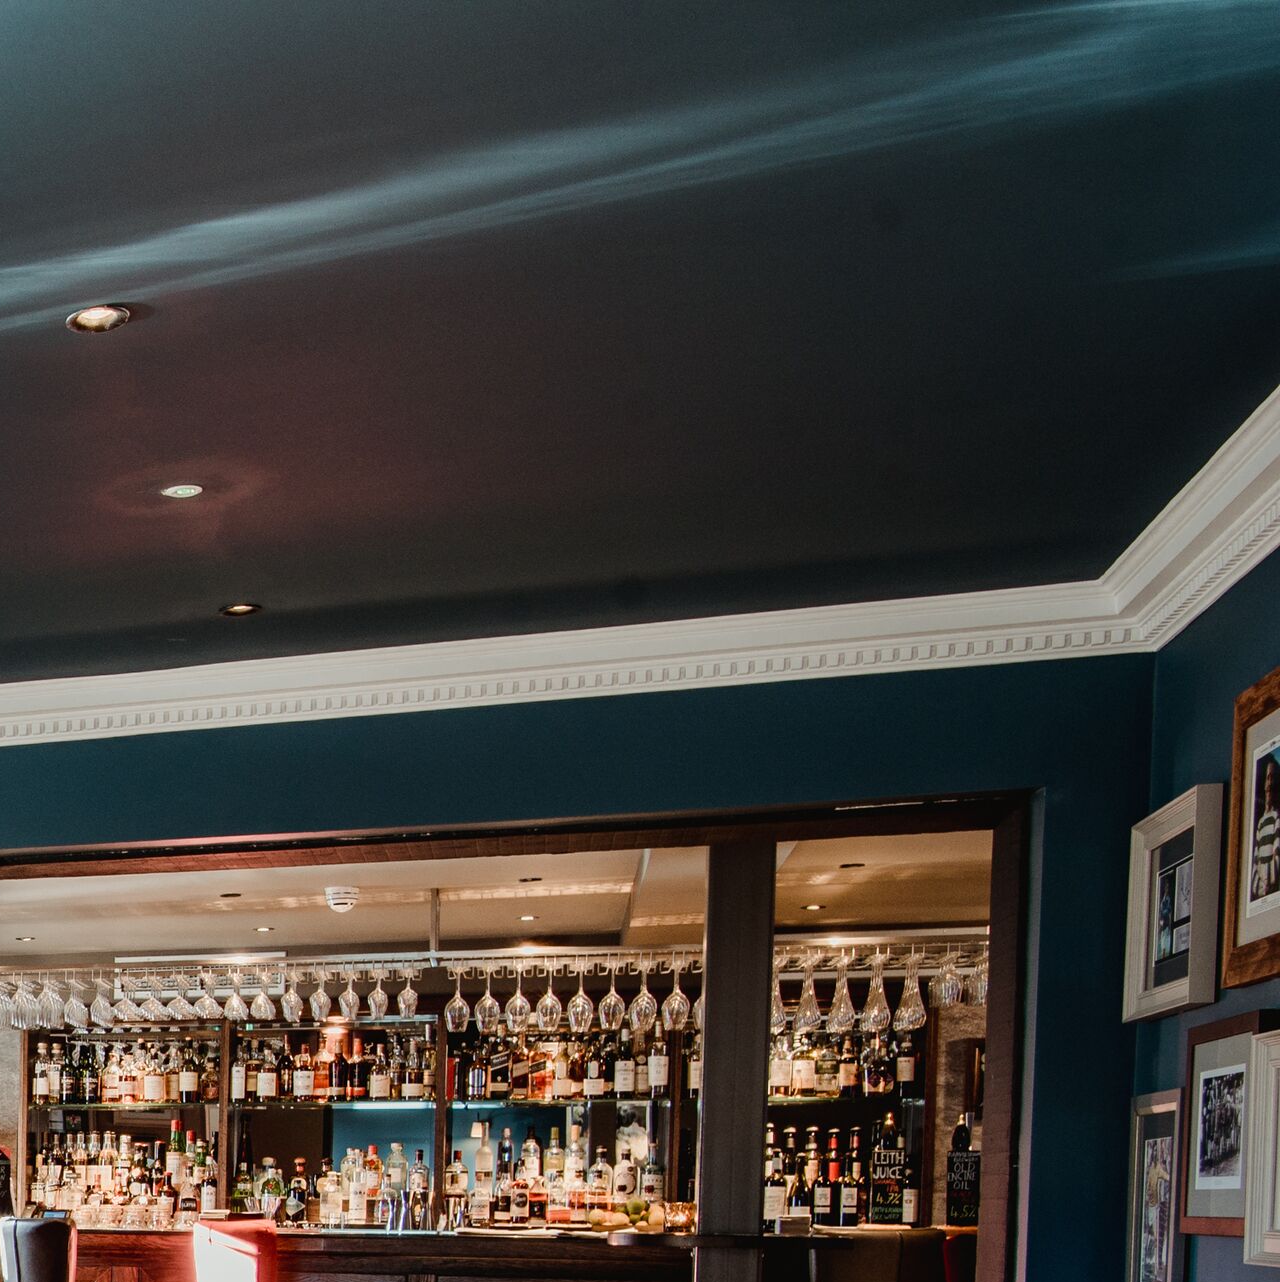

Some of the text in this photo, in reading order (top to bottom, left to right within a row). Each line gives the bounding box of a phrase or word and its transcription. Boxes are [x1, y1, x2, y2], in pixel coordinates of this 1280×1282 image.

[874, 1152, 904, 1164] LEITH
[954, 1162, 975, 1172] OLD
[873, 1166, 902, 1179] JUICE
[948, 1172, 976, 1181] ENGINE
[953, 1181, 969, 1190] OIL
